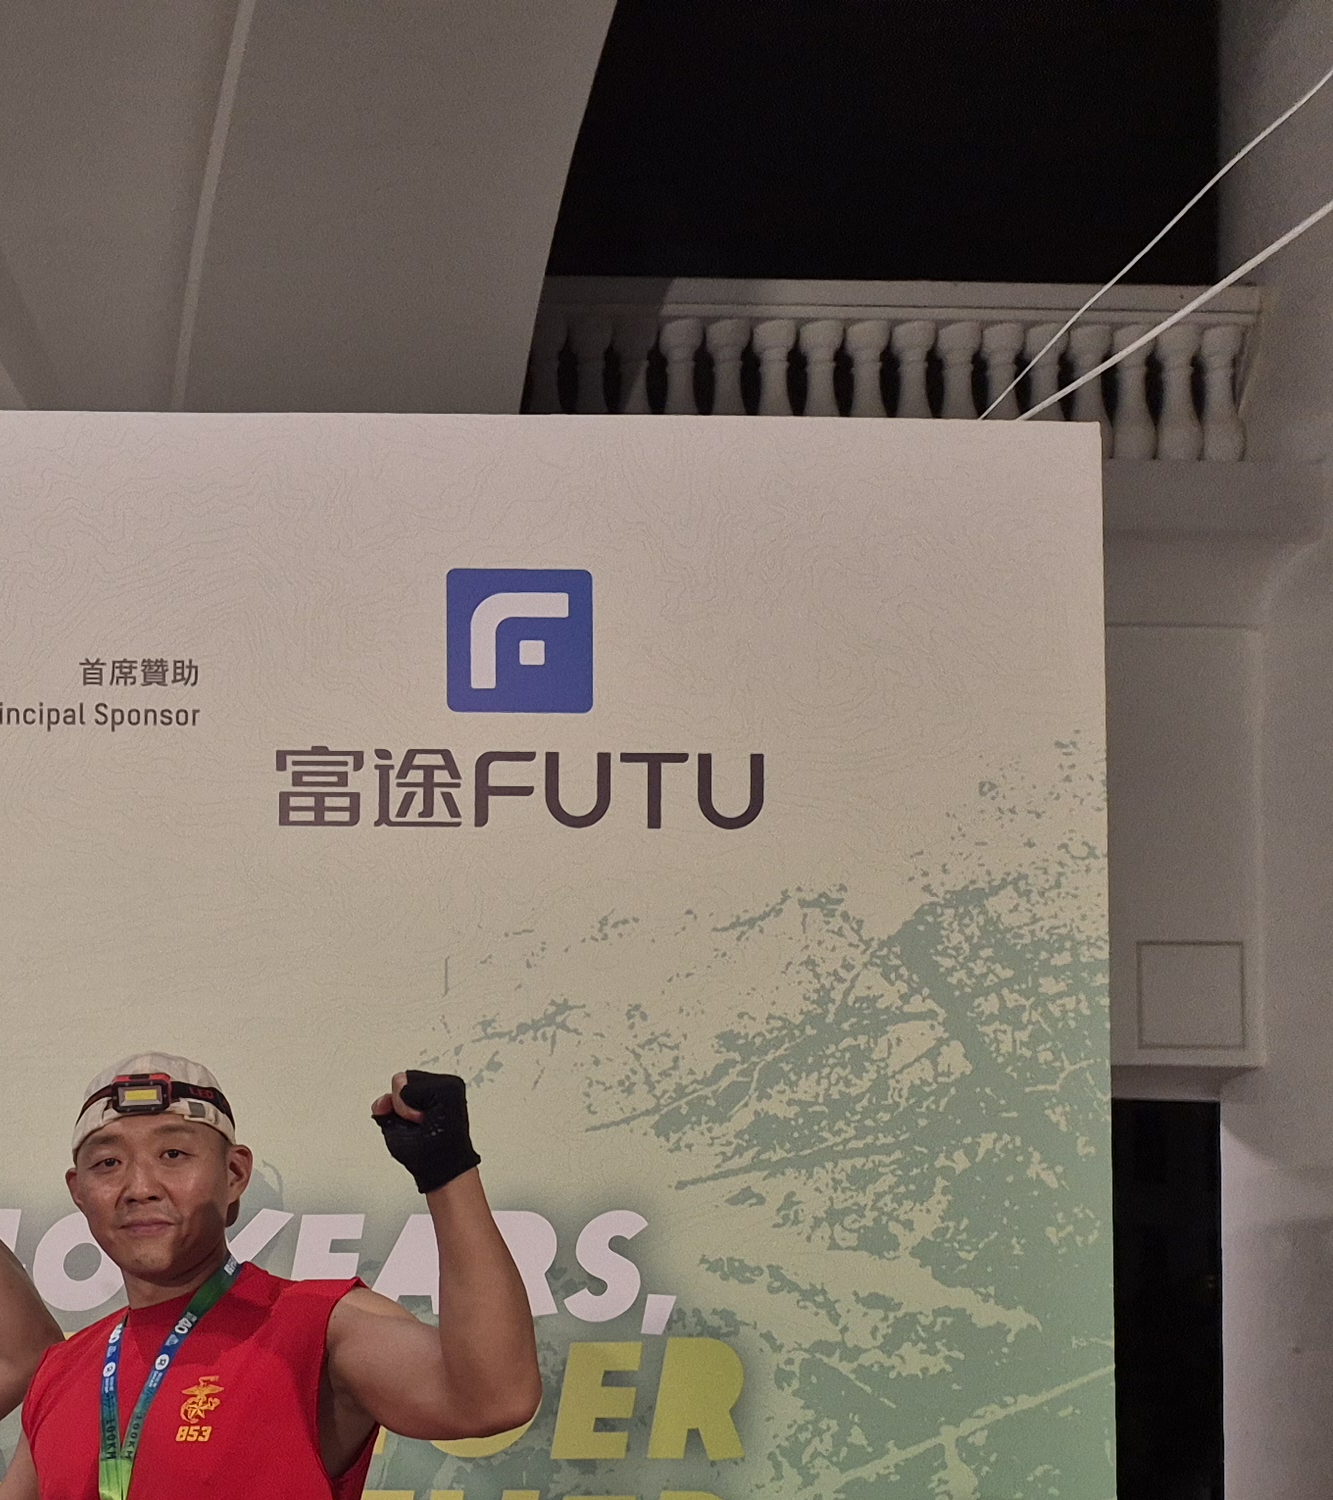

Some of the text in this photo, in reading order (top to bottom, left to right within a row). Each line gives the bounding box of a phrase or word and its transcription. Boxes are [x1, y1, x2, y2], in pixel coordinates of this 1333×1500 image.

[79, 658, 200, 687] 首席贊助
[94, 702, 201, 732] Sponsor
[176, 1425, 212, 1442] 853
